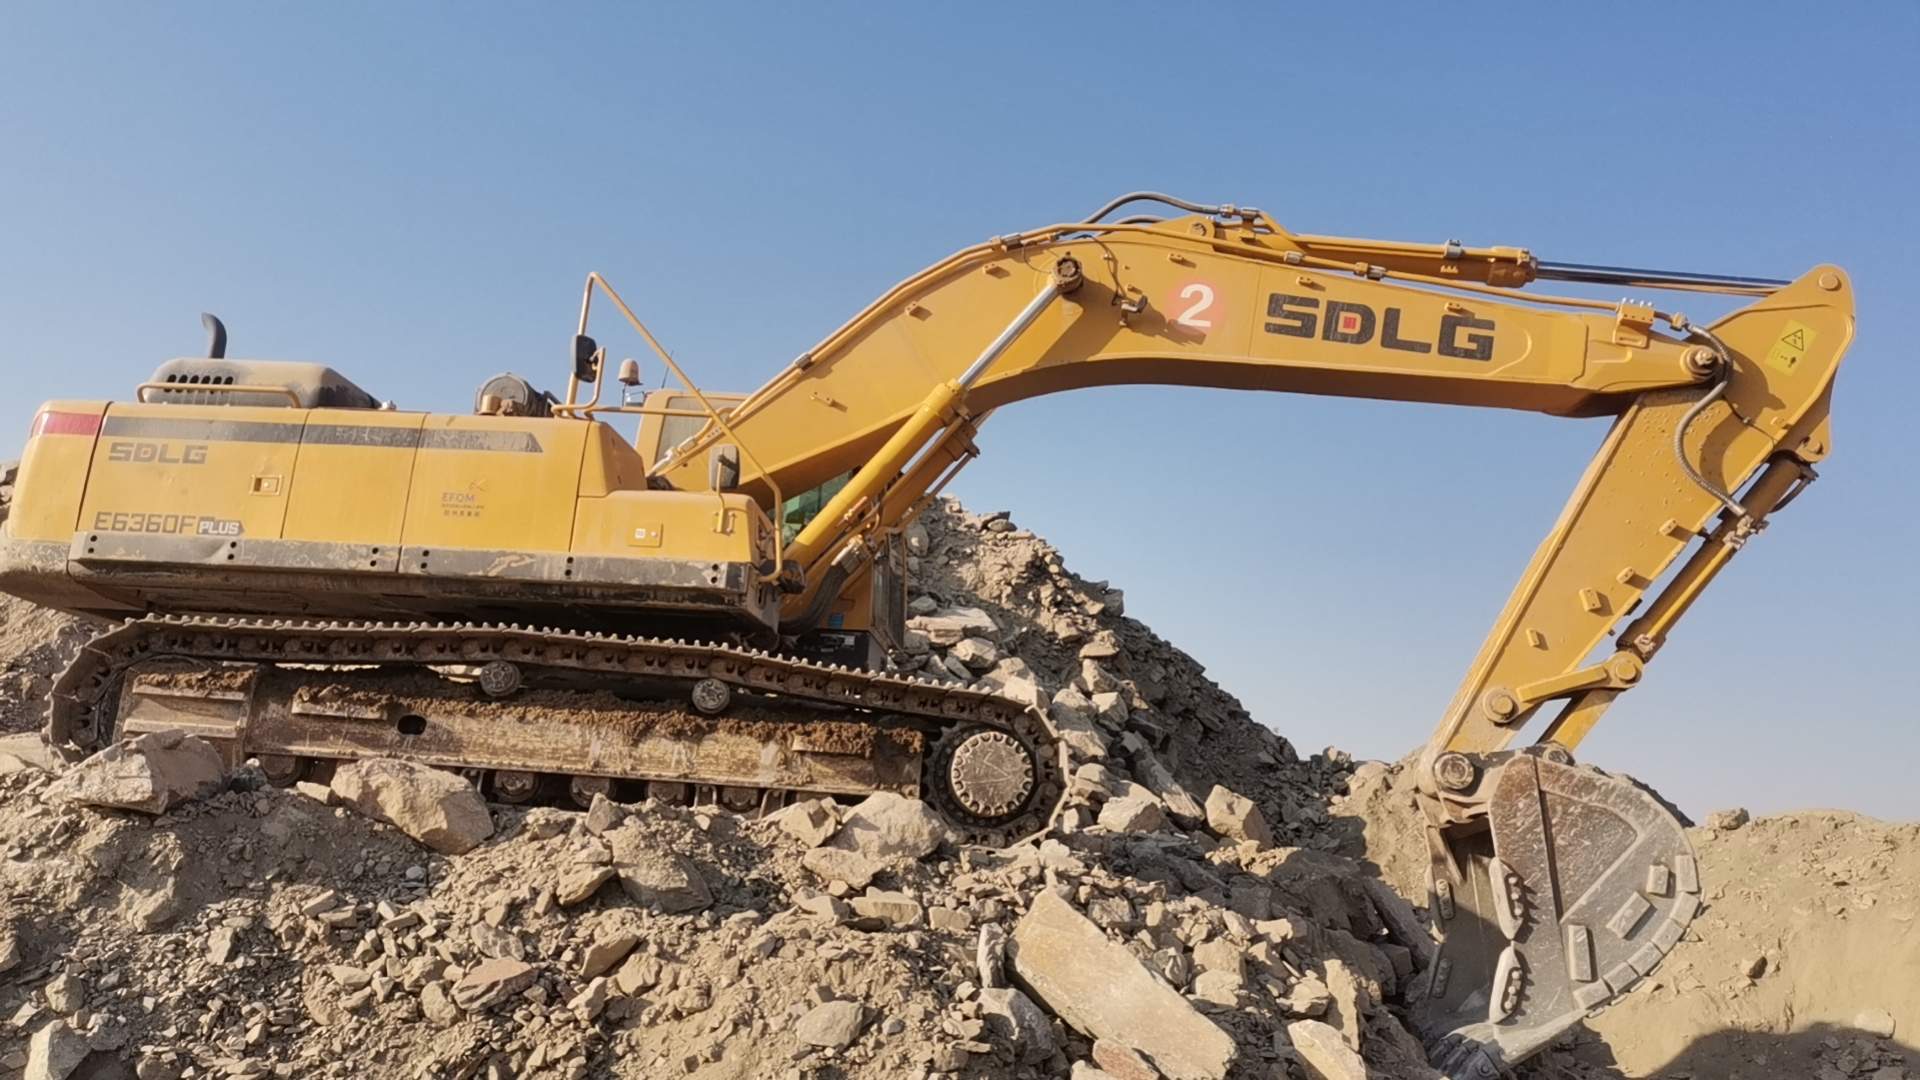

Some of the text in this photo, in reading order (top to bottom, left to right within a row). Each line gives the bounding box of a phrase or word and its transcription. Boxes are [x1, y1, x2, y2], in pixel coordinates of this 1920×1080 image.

[1176, 283, 1214, 327] 2
[1264, 292, 1496, 361] SDLG
[108, 441, 208, 464] SDLG
[94, 511, 241, 535] E6360F PLUS
